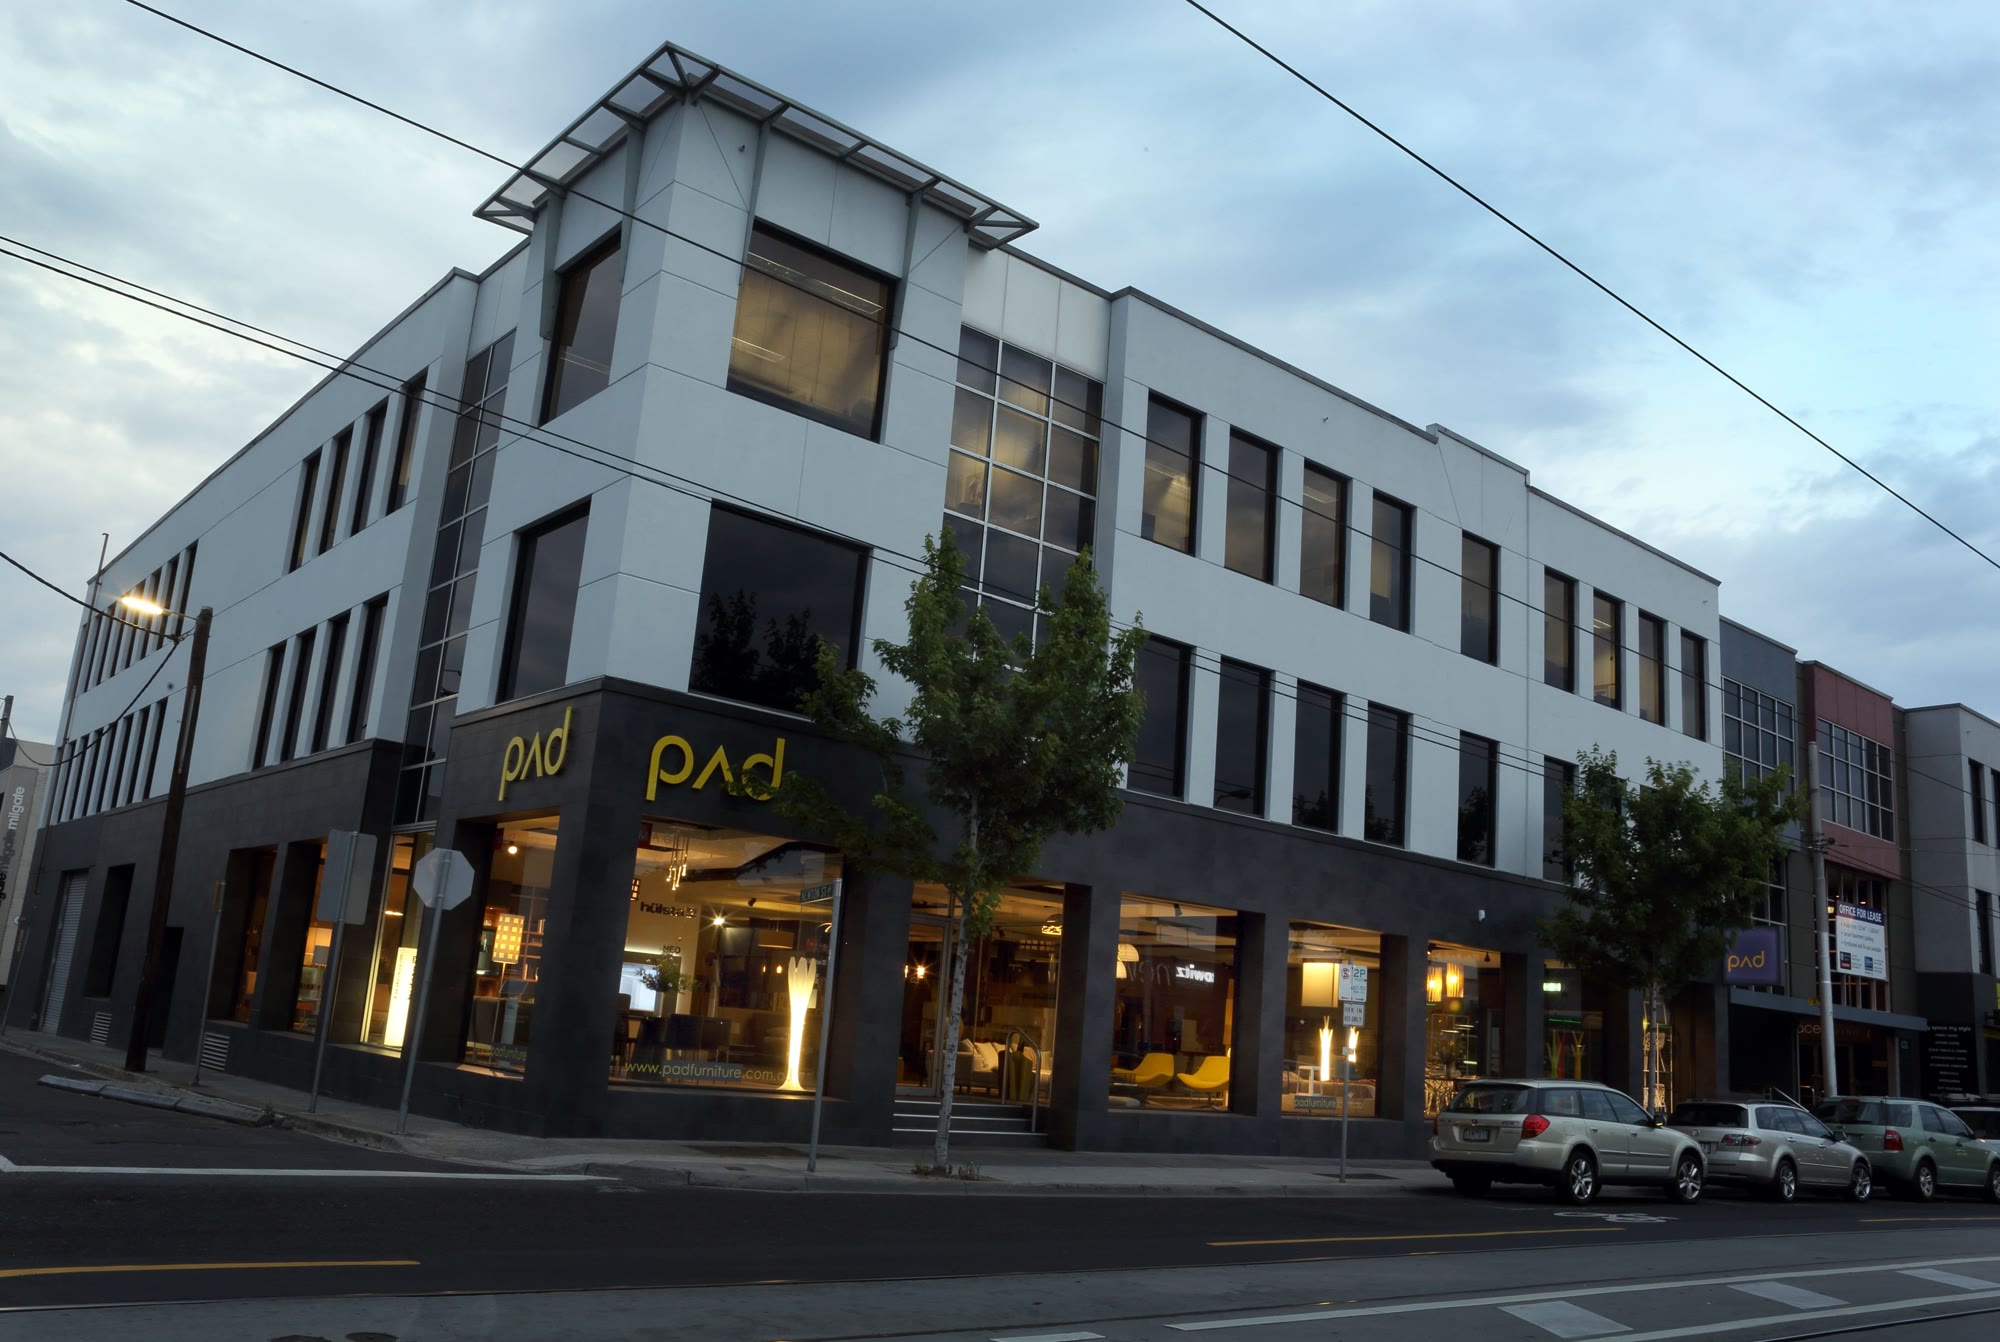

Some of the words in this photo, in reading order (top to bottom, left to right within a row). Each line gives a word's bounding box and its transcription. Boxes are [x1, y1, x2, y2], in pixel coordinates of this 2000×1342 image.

[8, 785, 25, 830] milgate
[640, 901, 685, 917] hülsta
[1839, 904, 1856, 917] OFFICE
[1857, 908, 1867, 919] FOR
[1867, 910, 1882, 923] LEASE
[662, 945, 681, 954] NEO
[1353, 968, 1365, 978] 2P
[625, 1060, 790, 1082] www.padfurniture.com.a
